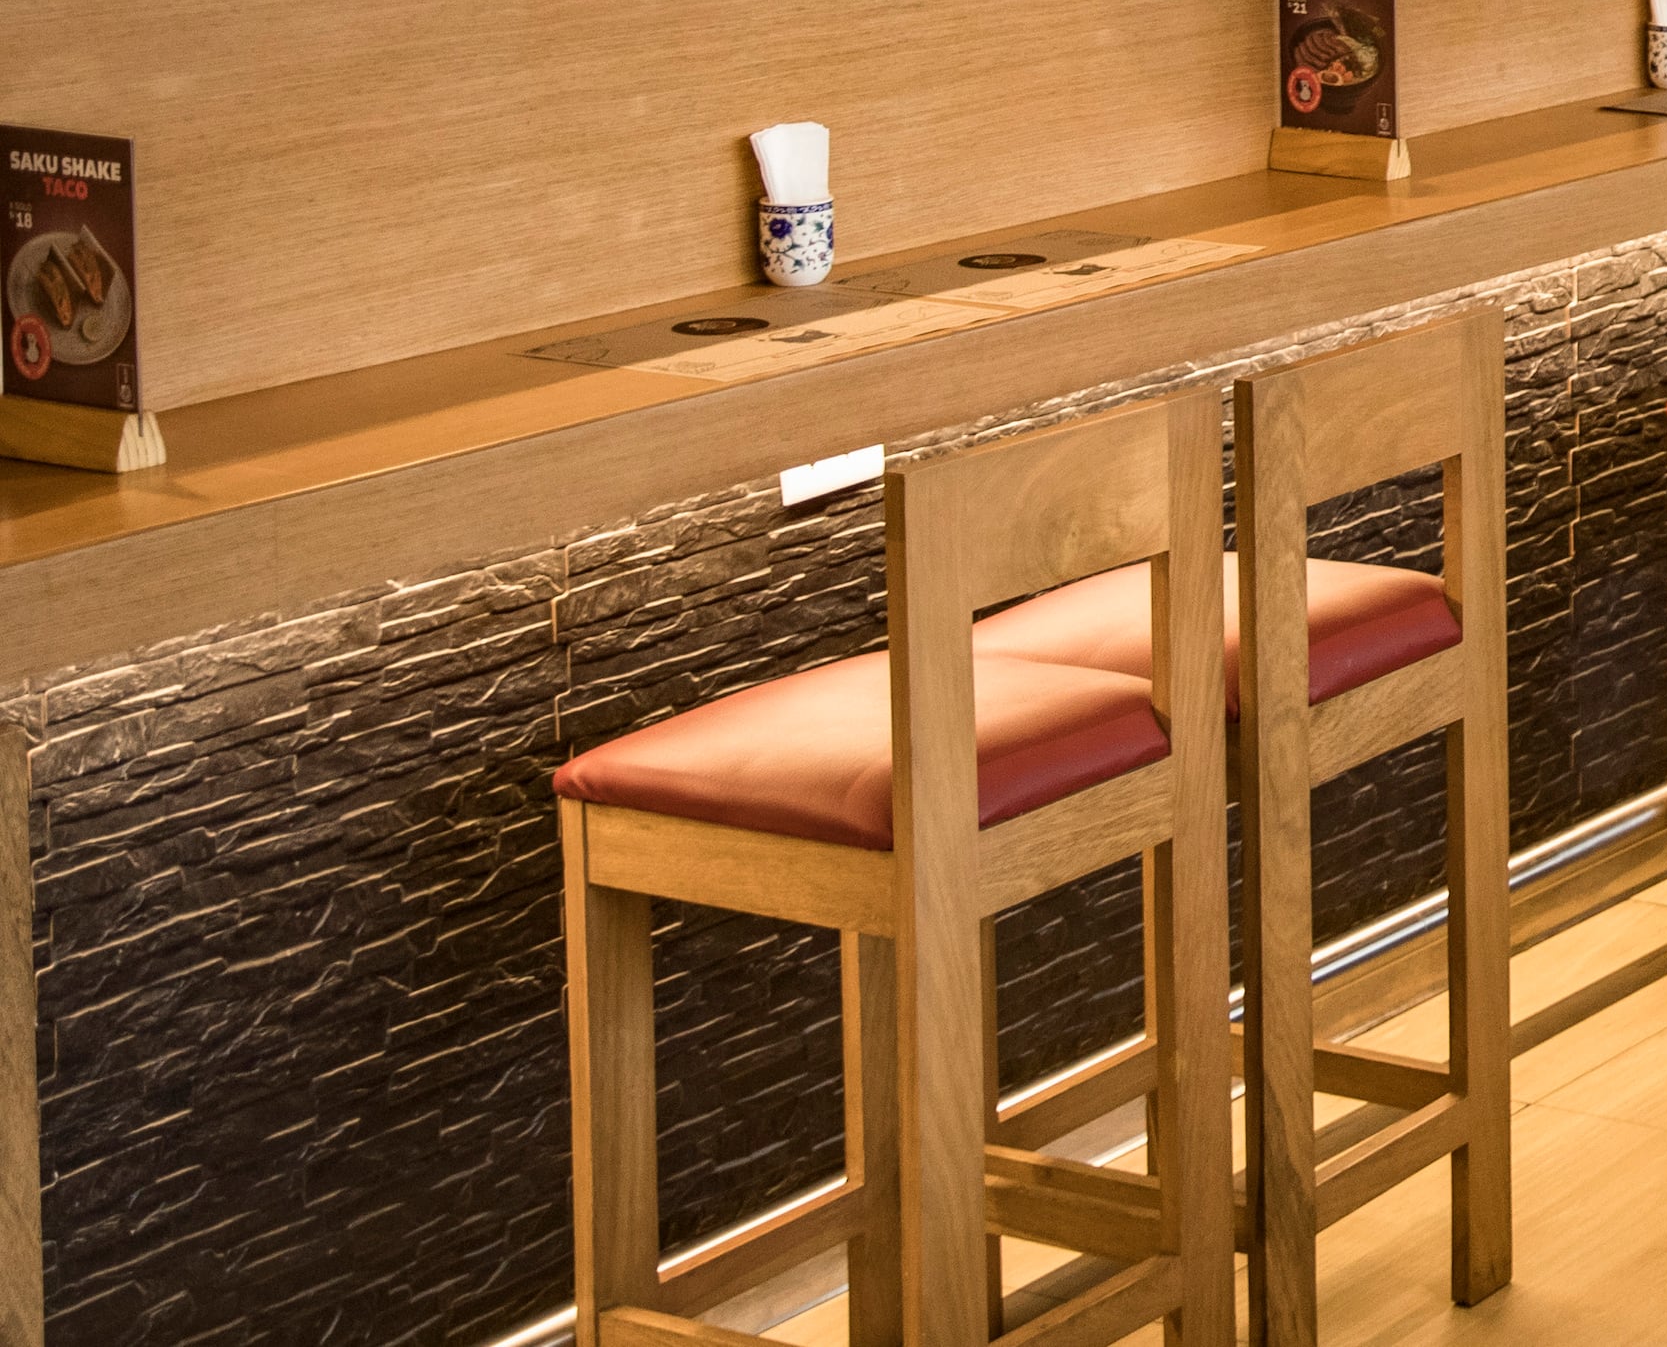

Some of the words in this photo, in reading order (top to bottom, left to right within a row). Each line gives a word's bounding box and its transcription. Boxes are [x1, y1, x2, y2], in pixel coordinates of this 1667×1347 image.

[9, 150, 59, 174] SAKU
[61, 156, 122, 182] SHAKE
[42, 176, 89, 200] TACO
